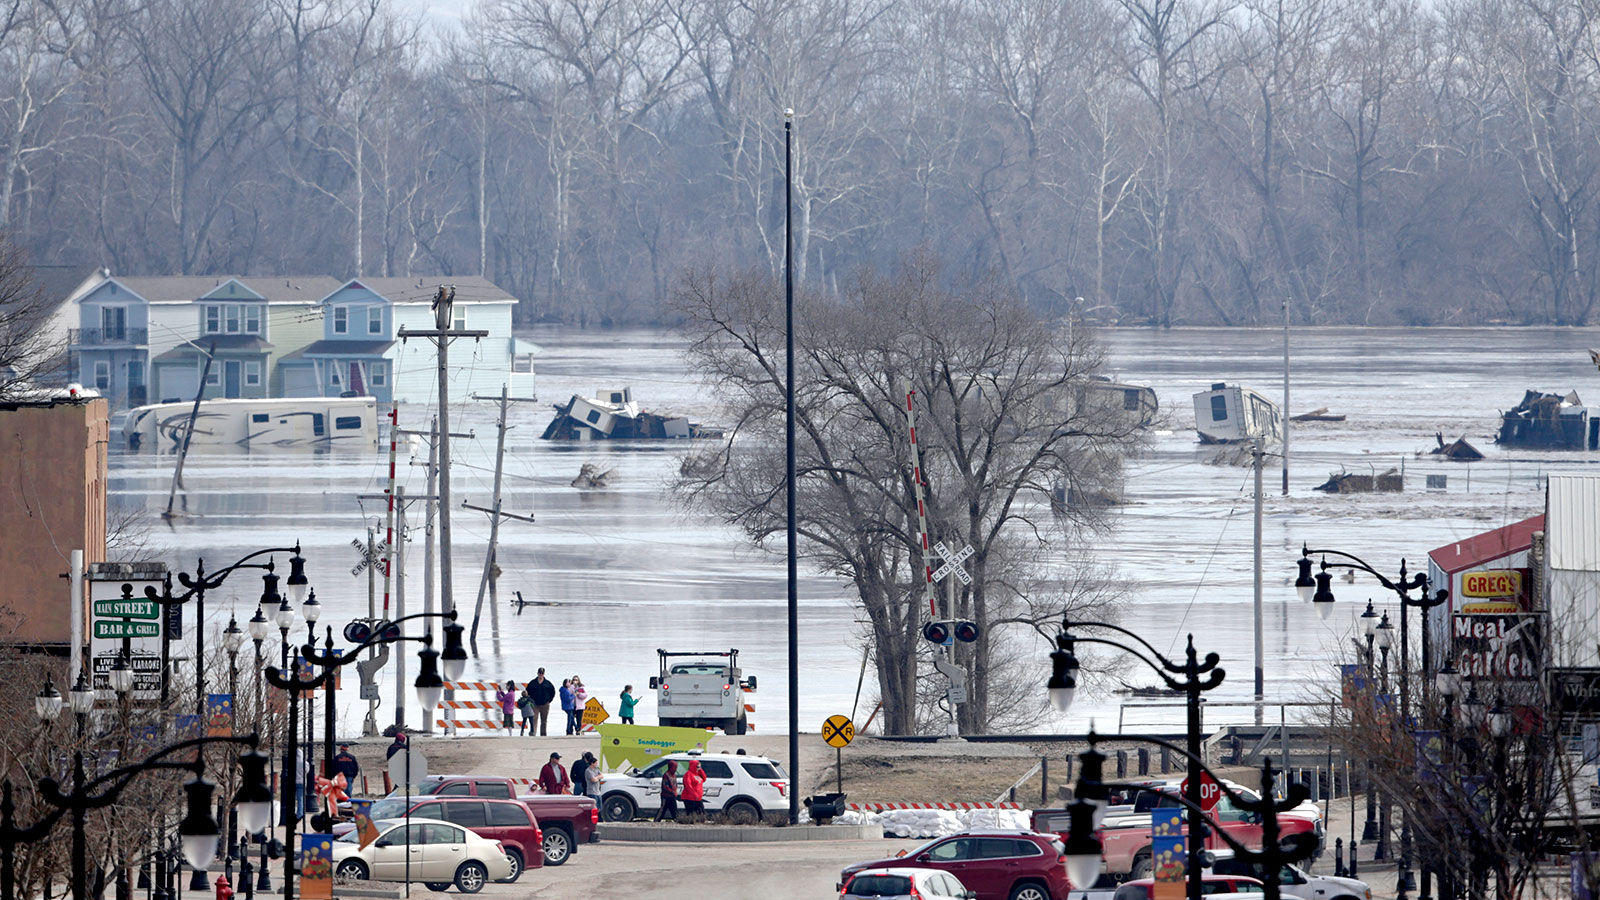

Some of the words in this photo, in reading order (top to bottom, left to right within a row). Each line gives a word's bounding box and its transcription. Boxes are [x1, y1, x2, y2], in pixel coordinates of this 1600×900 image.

[933, 546, 973, 580] CROSSING
[1468, 576, 1516, 592] GREG'S
[96, 603, 112, 614] MAIN
[114, 602, 154, 614] STREET
[100, 624, 123, 634] BAR
[126, 625, 134, 634] &
[136, 625, 156, 634] GRILL
[1454, 616, 1506, 638] Meat
[132, 660, 160, 670] KARAOKE
[638, 738, 676, 748] Sandbagger
